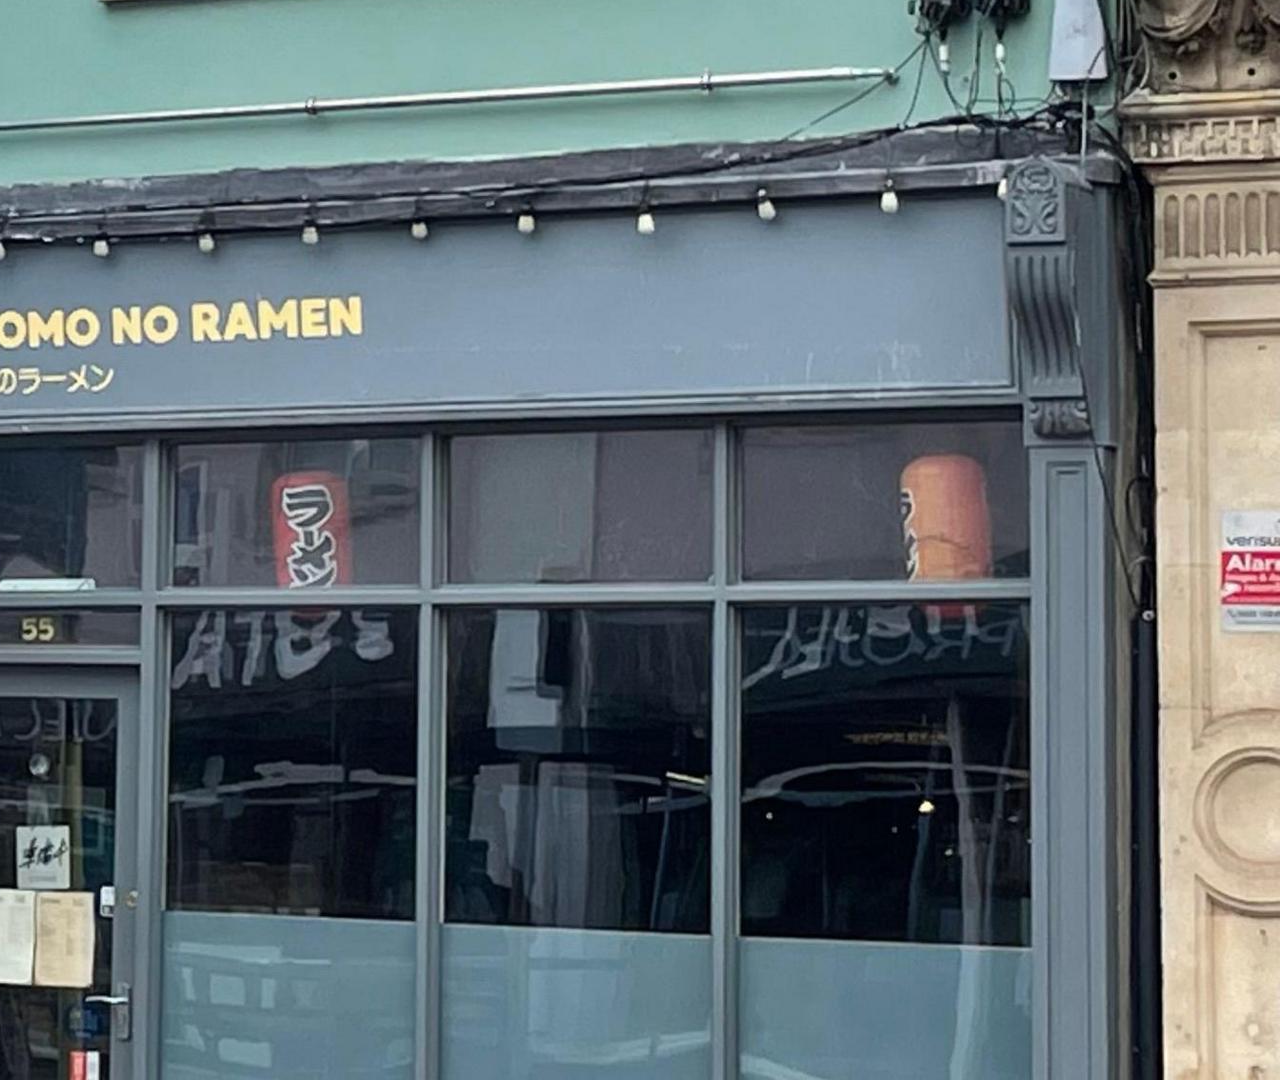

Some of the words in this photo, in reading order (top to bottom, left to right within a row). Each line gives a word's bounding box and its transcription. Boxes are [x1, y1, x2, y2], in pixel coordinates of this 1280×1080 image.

[111, 305, 180, 345] NO
[191, 295, 363, 343] RAMEN
[20, 617, 55, 641] 55
